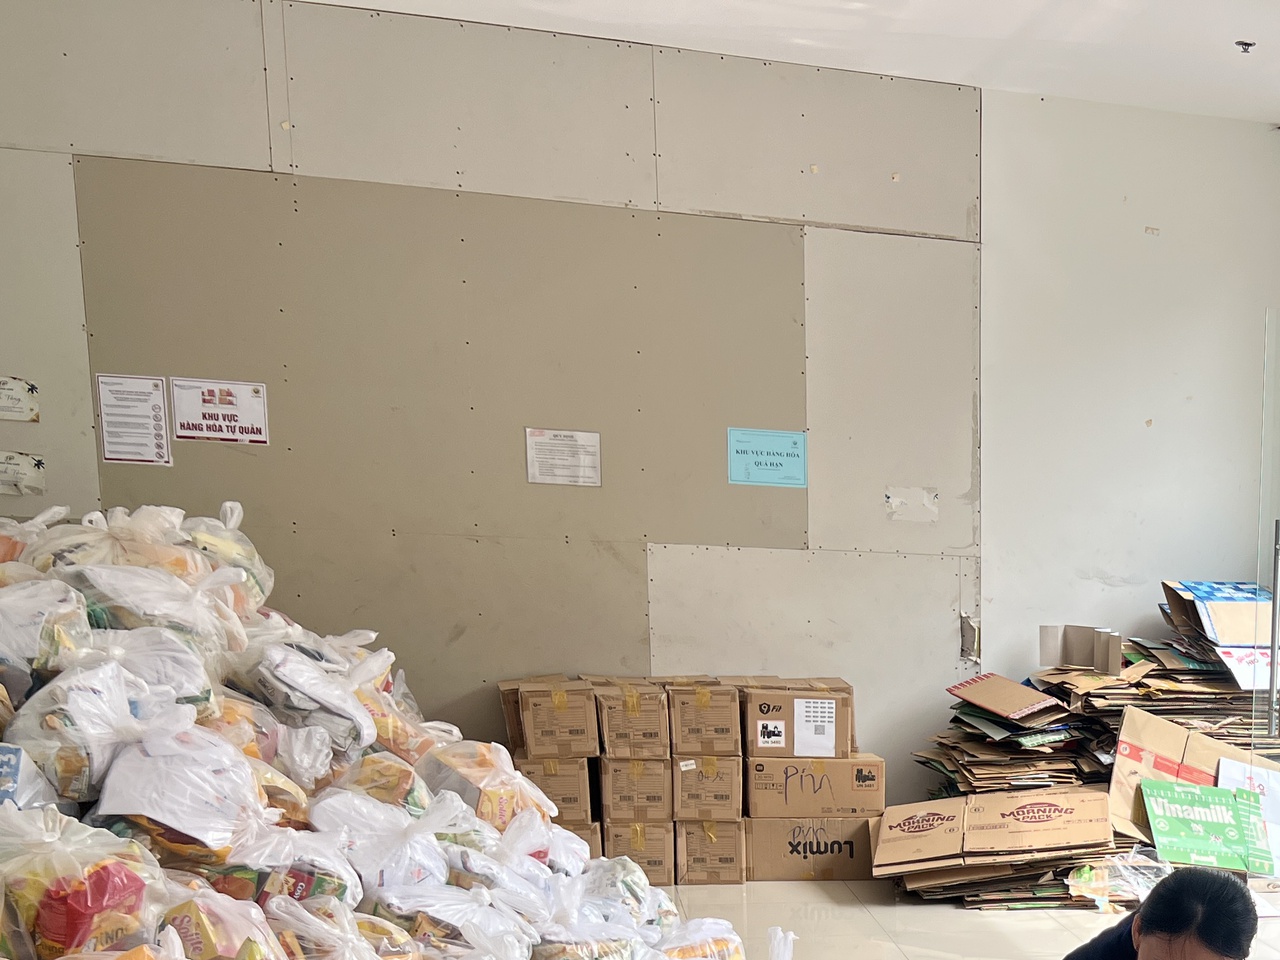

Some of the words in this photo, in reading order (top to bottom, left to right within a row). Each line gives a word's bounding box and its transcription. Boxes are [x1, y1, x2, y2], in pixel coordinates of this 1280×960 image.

[202, 412, 219, 421] KHU
[222, 413, 239, 425] VỰC
[180, 421, 203, 431] HÀNG
[1000, 806, 1075, 820] MORNING
[1150, 796, 1237, 824] Vinamilk
[906, 823, 935, 831] PACK
[788, 840, 854, 860] Lumix
